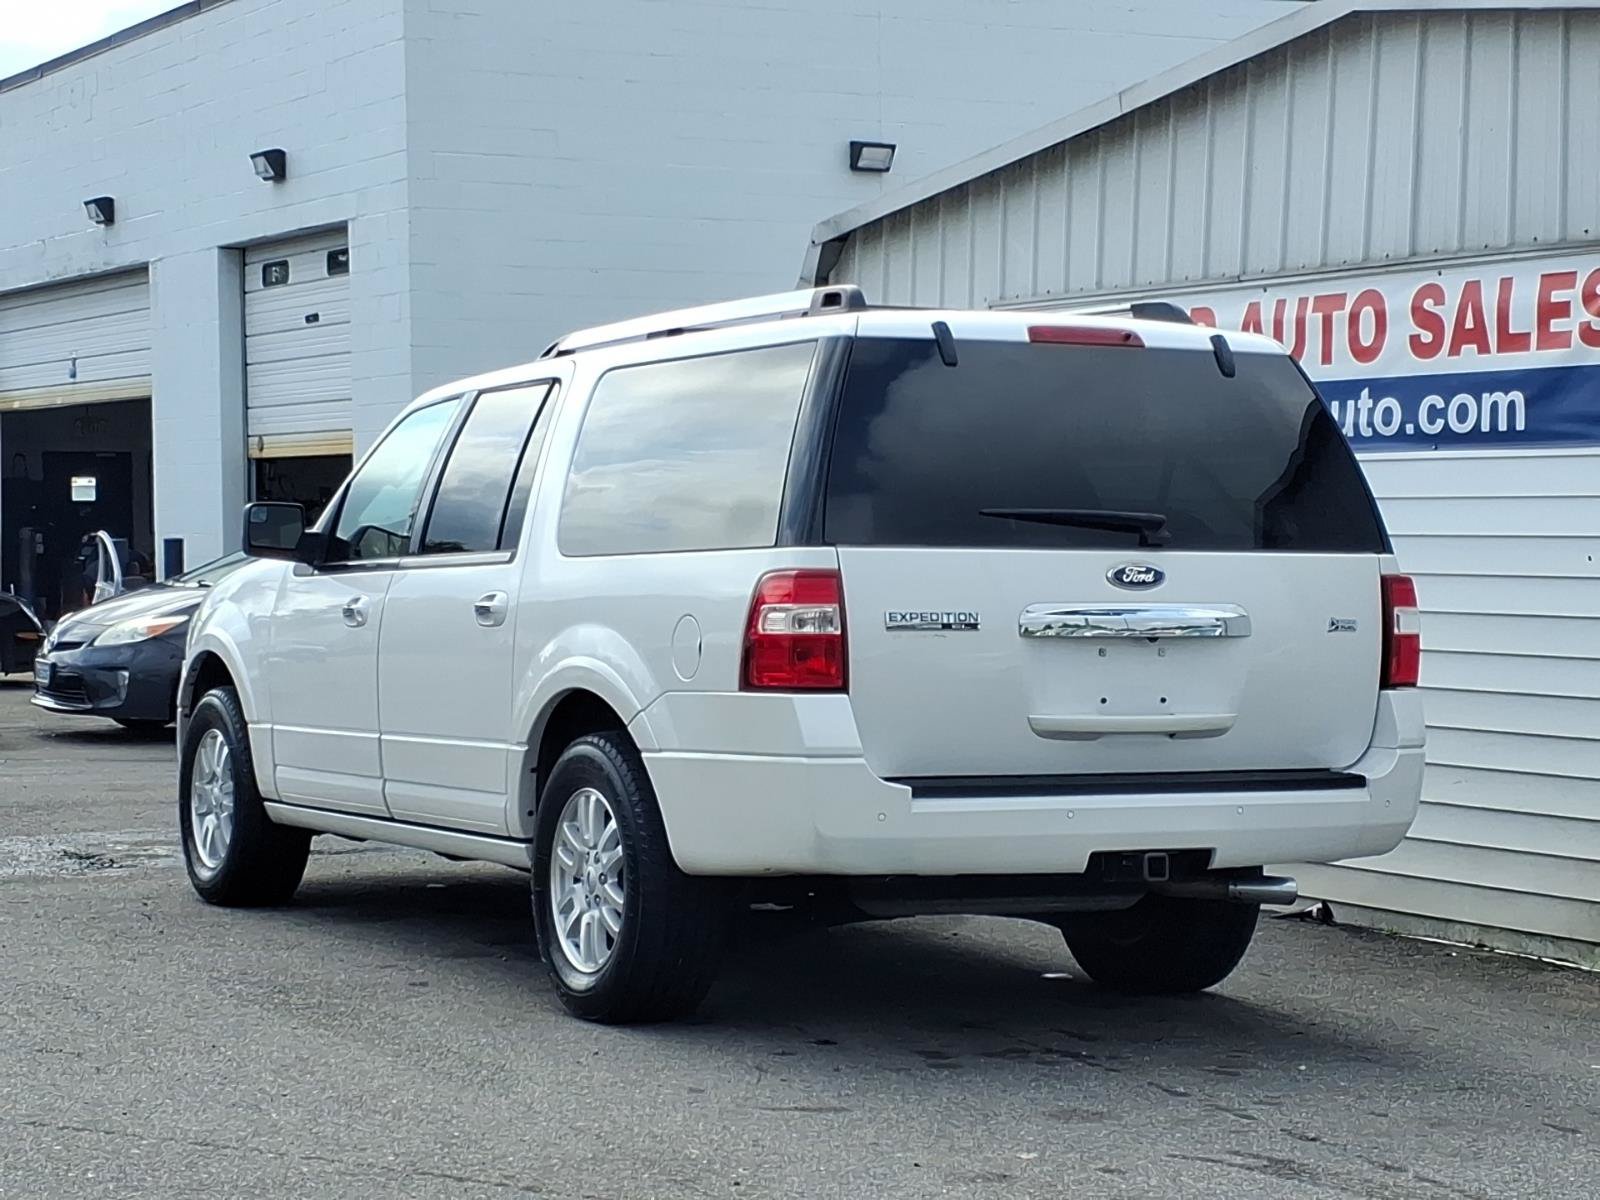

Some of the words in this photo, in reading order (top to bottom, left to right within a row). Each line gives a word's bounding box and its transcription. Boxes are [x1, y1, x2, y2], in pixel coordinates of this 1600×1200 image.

[1408, 266, 1600, 361] SALES
[1122, 566, 1155, 582] Ford
[888, 611, 979, 622] EXPEDITION
